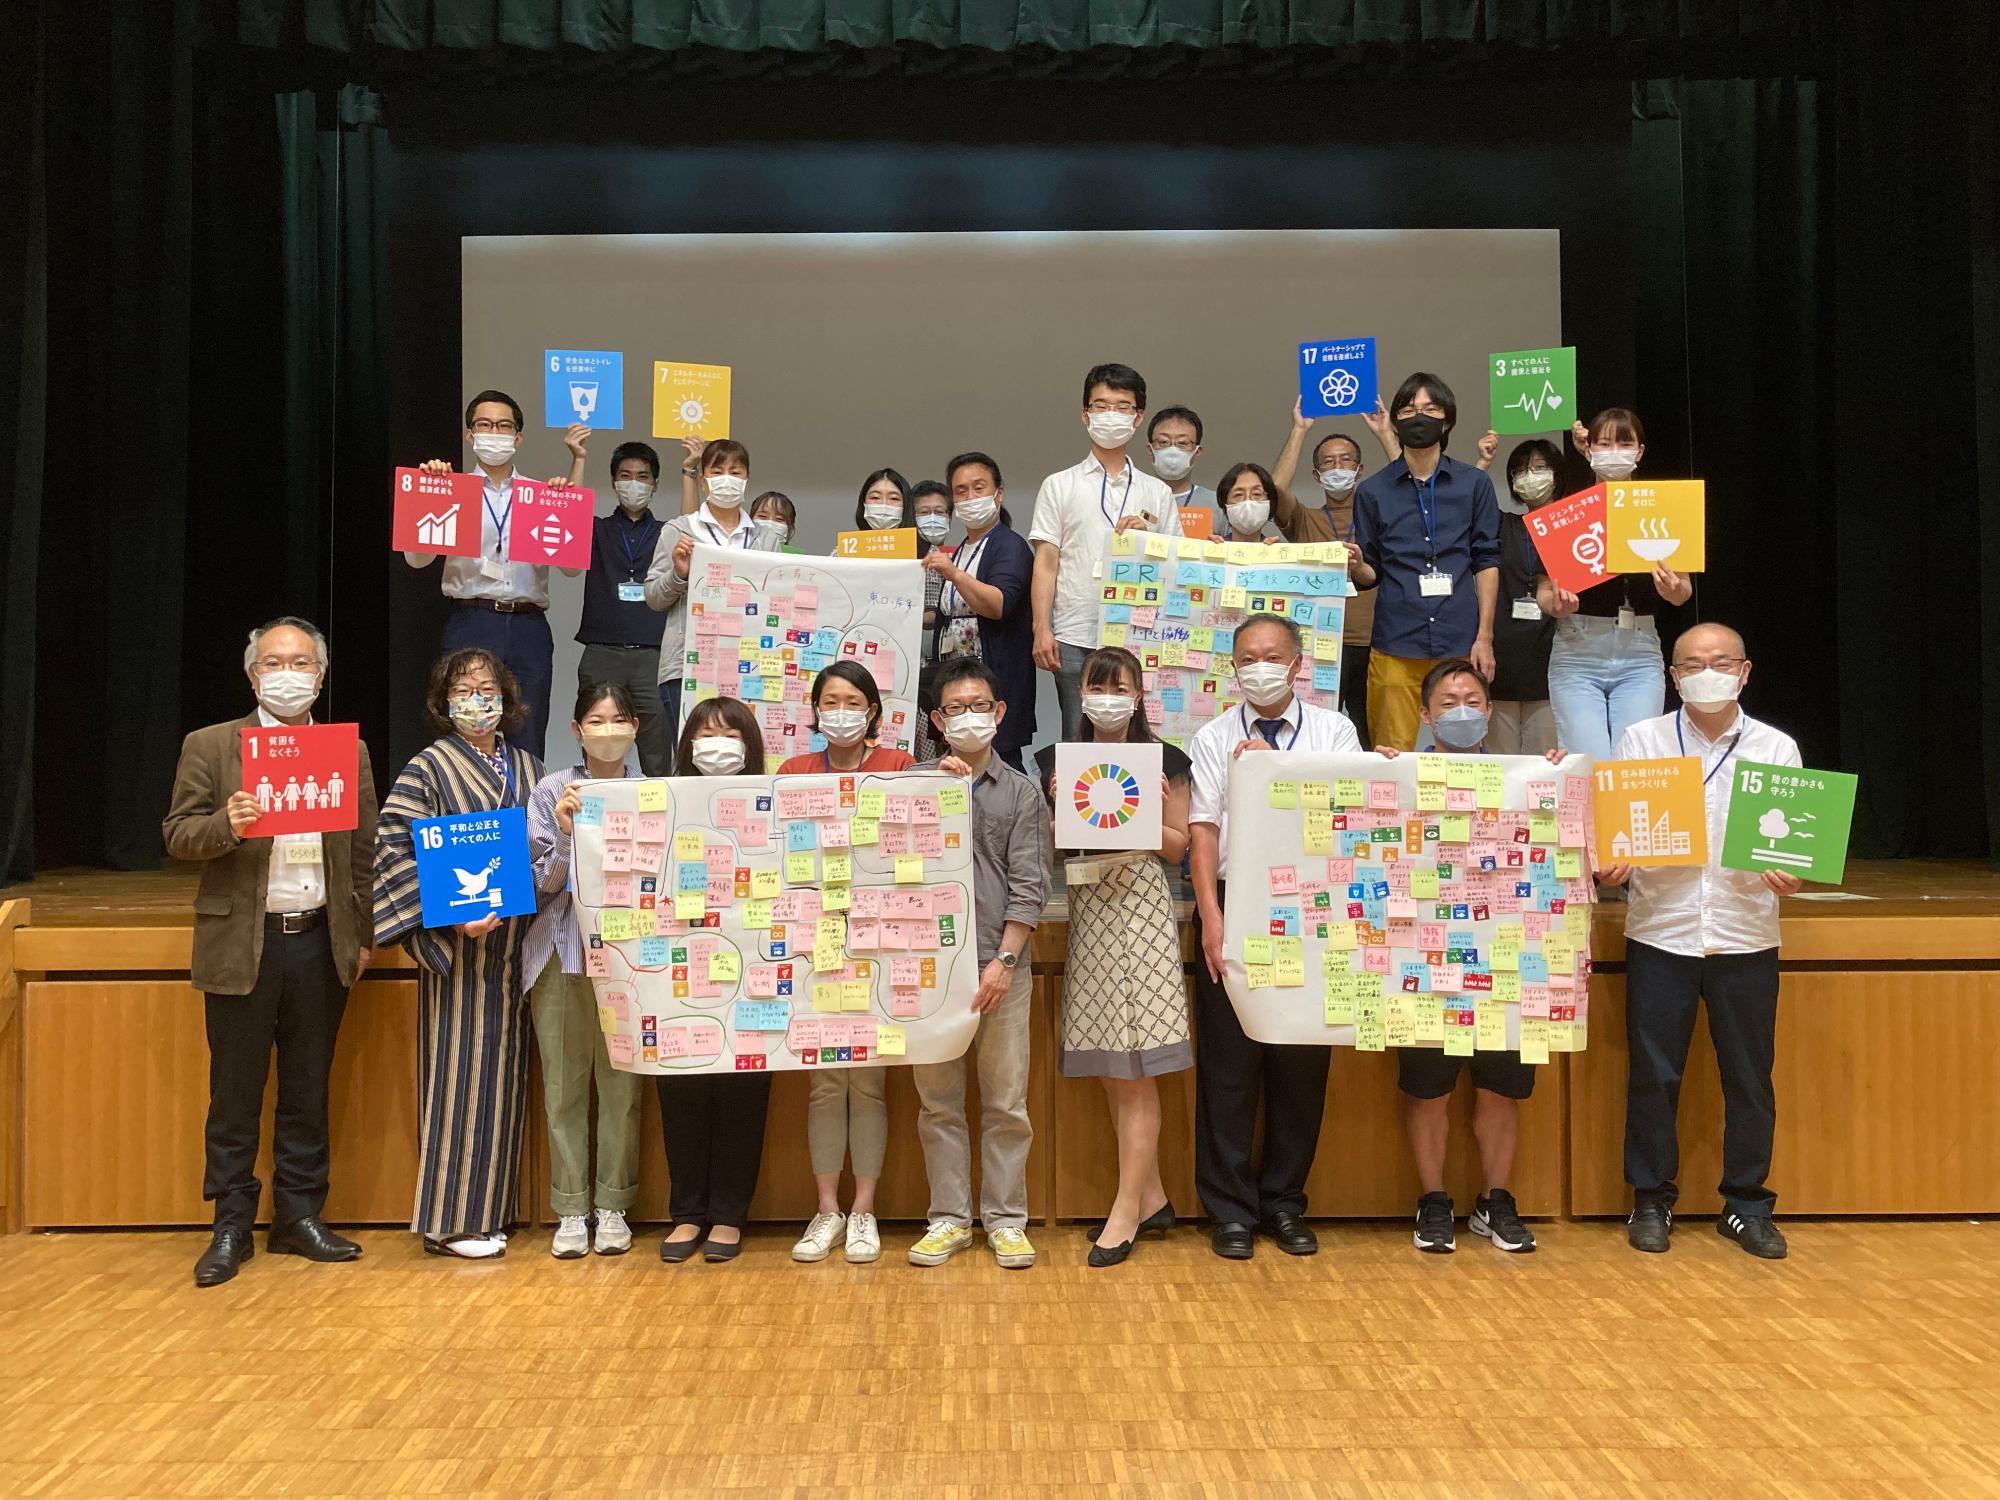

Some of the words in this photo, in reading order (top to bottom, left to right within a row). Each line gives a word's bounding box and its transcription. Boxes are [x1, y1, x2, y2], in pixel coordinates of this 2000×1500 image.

[1302, 347, 1317, 364] 17
[1321, 344, 1366, 353] パートナーシップで
[550, 356, 560, 372] 6
[565, 357, 611, 365] 安全な水とトイレ
[1322, 352, 1365, 362] 目標を達成しよう
[1511, 357, 1550, 367] すべての人に
[565, 365, 596, 373] を世界中に
[1495, 359, 1506, 377] 3
[1511, 366, 1551, 376] 健康と福祉を
[660, 368, 669, 384] 7
[401, 474, 413, 492] 8
[419, 476, 453, 486] 働きがいも
[419, 486, 453, 496] 経済成長も
[517, 486, 534, 504] 10
[540, 489, 584, 502] 人や国の不平等
[1613, 488, 1625, 508] 2
[539, 499, 568, 508] をなくそう
[1549, 494, 1601, 520] ジェンダー平等を
[1632, 498, 1656, 507] ゼロに
[1532, 517, 1548, 537] 5
[1552, 512, 1585, 529] 実現しよう
[842, 537, 858, 554] 12
[1115, 564, 1155, 583] PR
[248, 736, 258, 759] 1
[268, 735, 296, 746] 貧困を
[268, 747, 300, 758] なくそう
[1595, 769, 1614, 792] 11
[1620, 767, 1680, 779] 住み続けられる
[1621, 778, 1669, 790] まちづくりを
[1740, 769, 1764, 794] 15
[1771, 774, 1825, 790] 陸の豊かさも
[1770, 786, 1796, 799] 守ろう
[449, 819, 500, 834] 平和と公正を
[419, 825, 444, 849] 16
[450, 832, 501, 846] すべての人に
